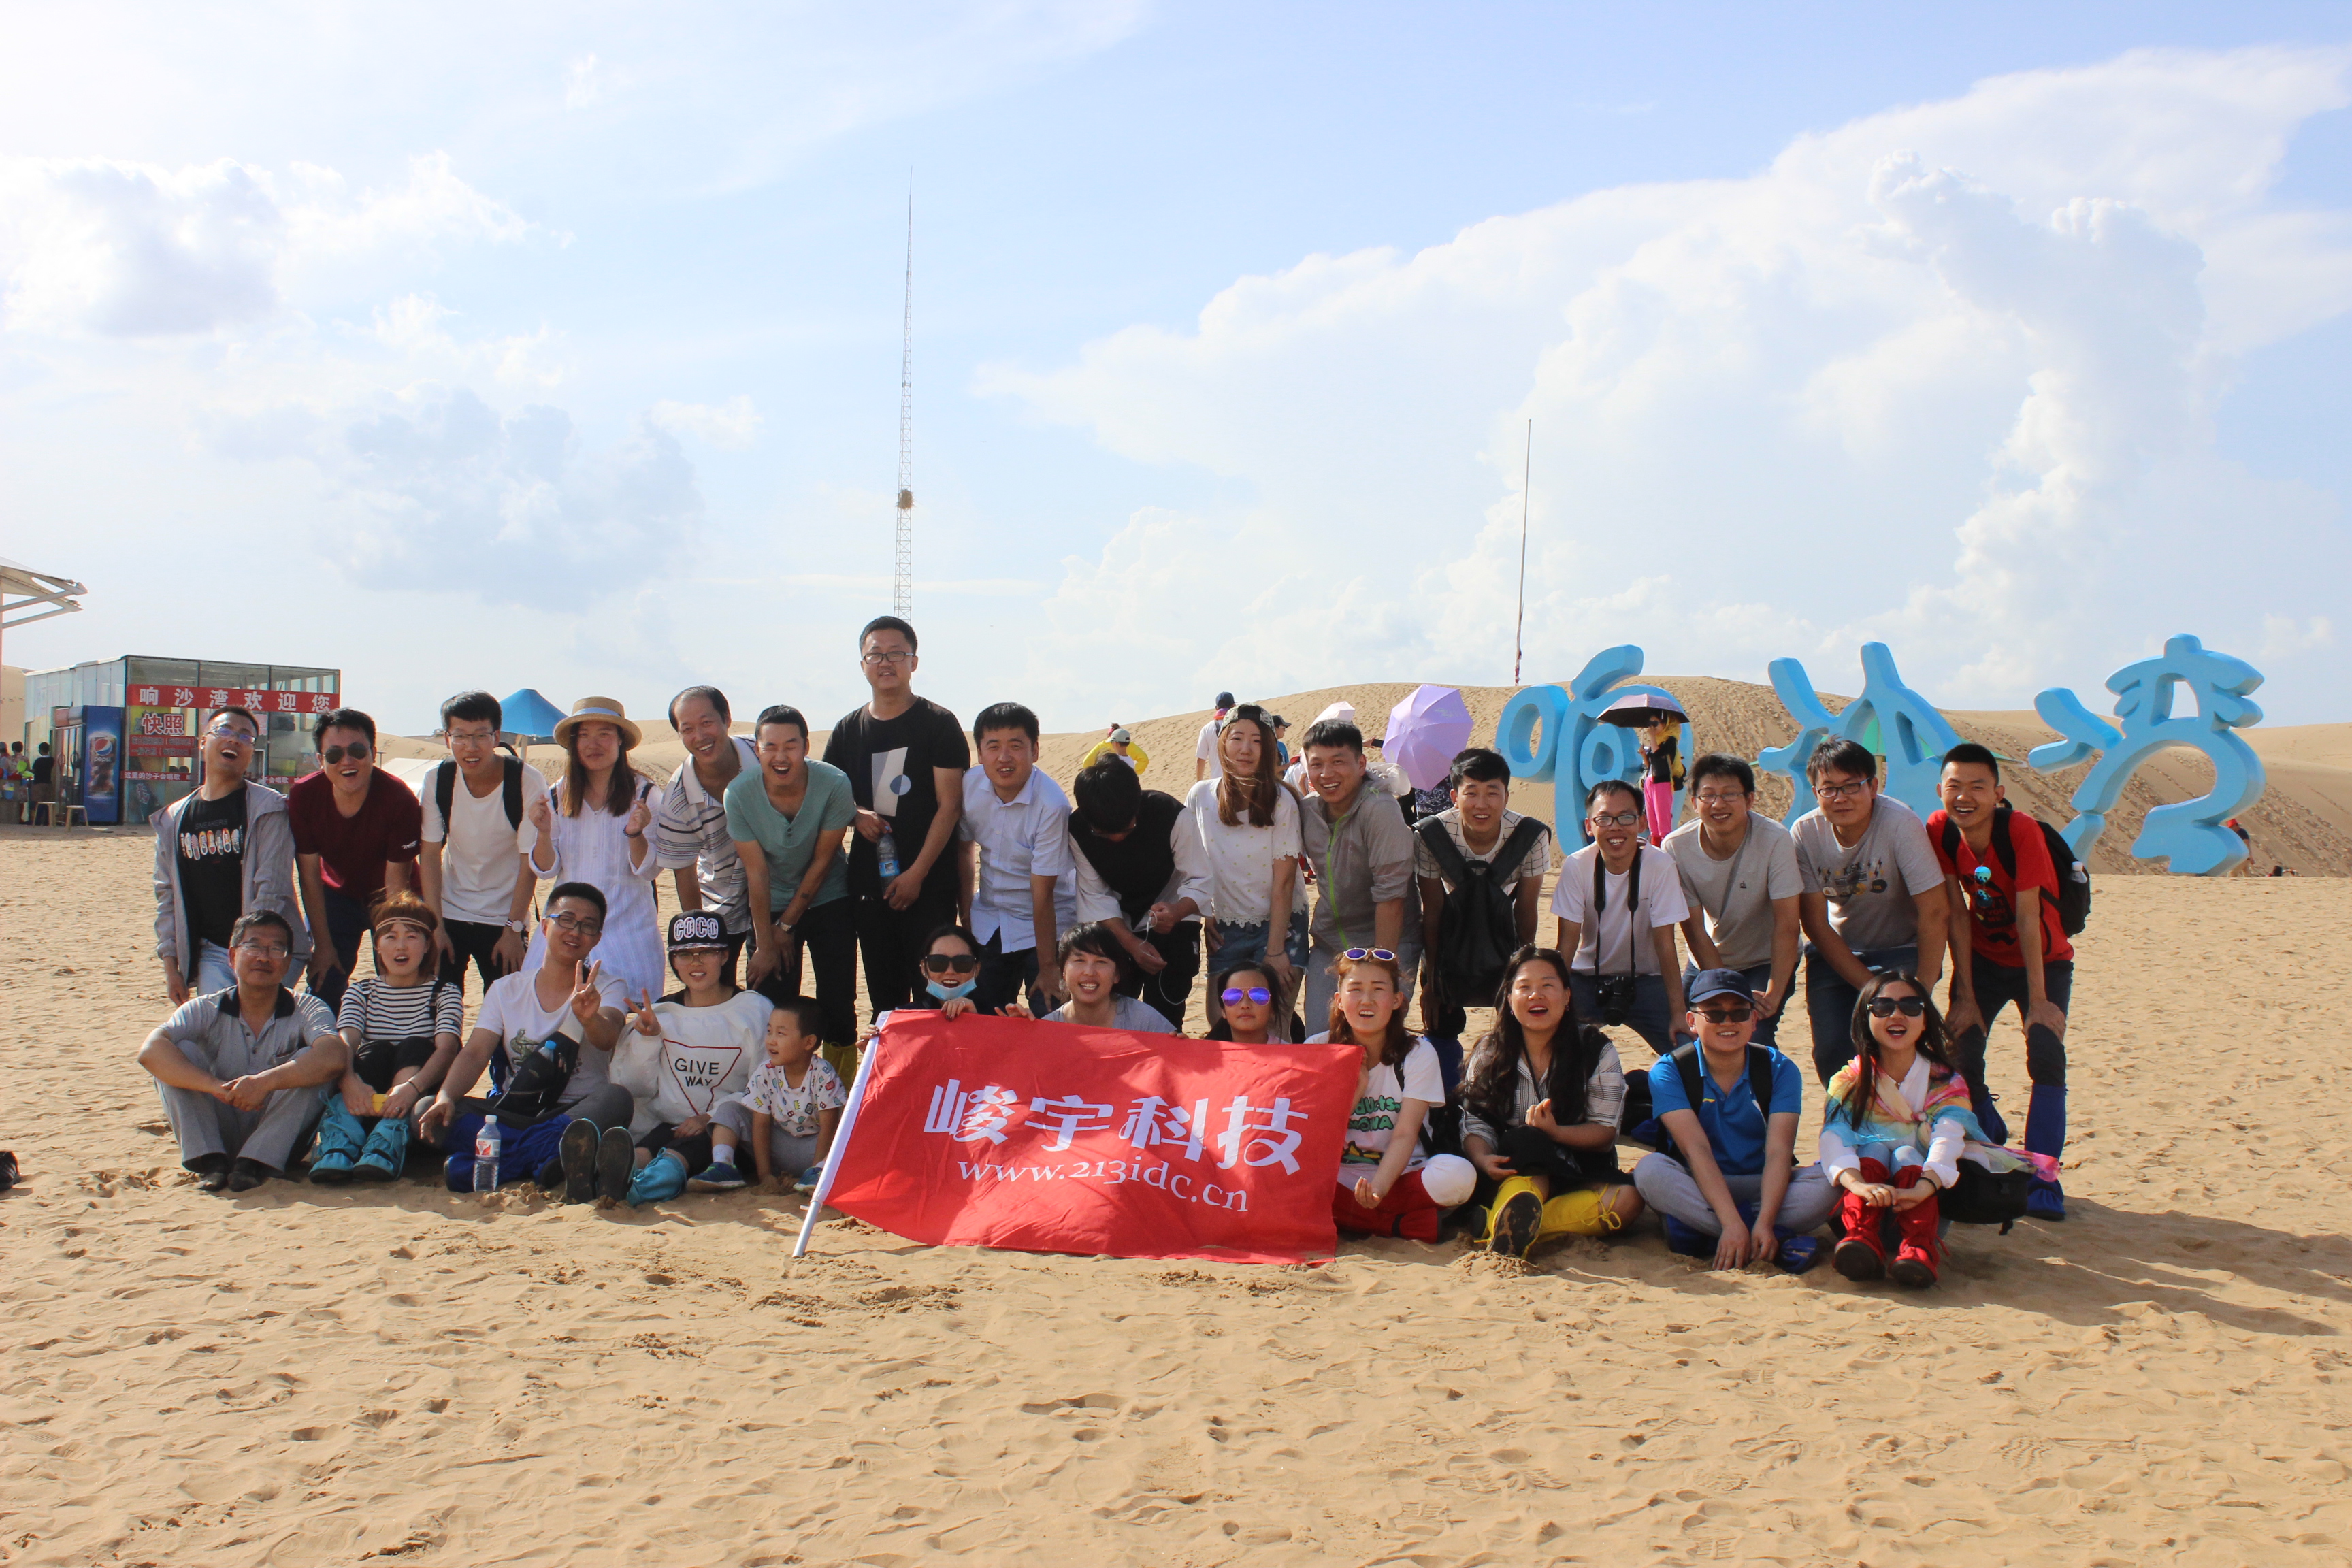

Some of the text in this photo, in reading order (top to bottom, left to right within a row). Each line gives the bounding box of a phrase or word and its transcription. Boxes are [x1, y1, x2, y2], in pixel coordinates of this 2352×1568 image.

[140, 686, 330, 713] 响沙湾欢迎您
[141, 713, 184, 735] 快照
[195, 819, 228, 830] SNEAKERS
[674, 916, 719, 941] COCO
[674, 1058, 720, 1075] GIVE
[685, 1075, 713, 1088] WAY
[923, 1078, 1309, 1176] 峻宇科技
[957, 1156, 1248, 1212] www.213idc.cn
